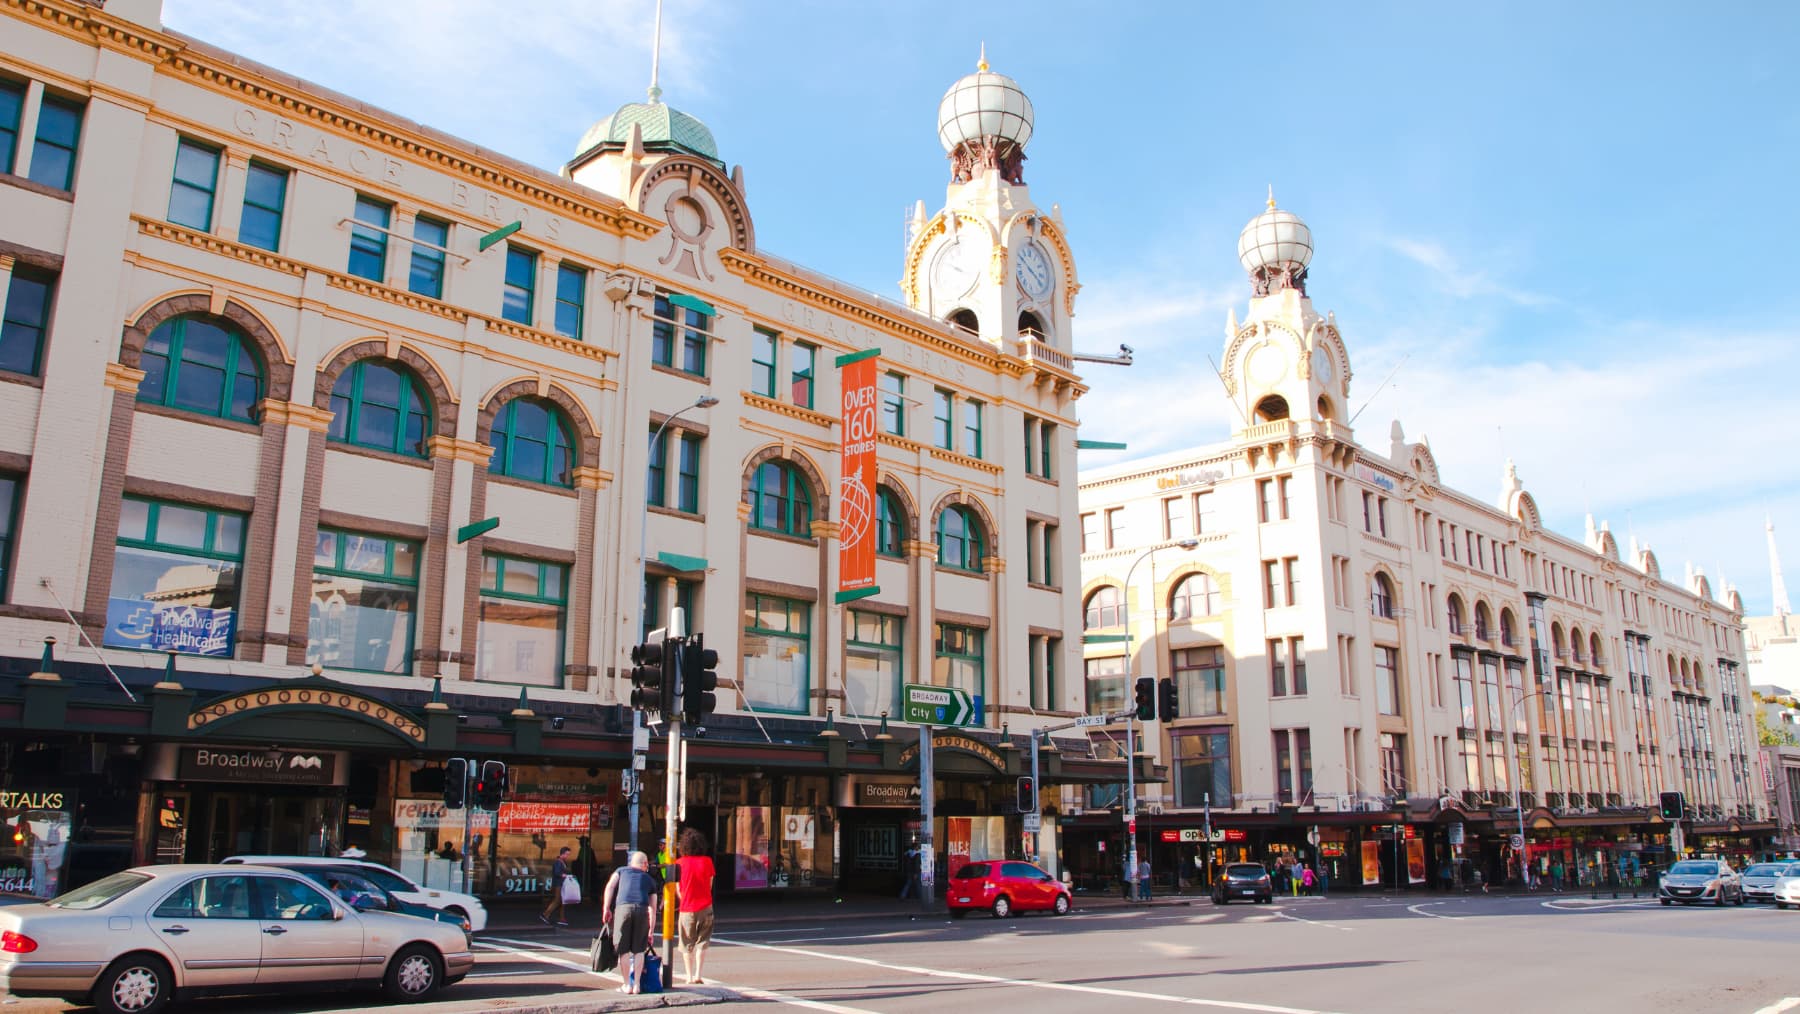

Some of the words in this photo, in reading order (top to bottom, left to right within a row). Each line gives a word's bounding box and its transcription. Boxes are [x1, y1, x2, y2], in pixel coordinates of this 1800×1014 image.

[451, 181, 561, 241] BROS
[844, 385, 875, 410] OVER
[843, 407, 875, 442] 160
[844, 439, 875, 457] STORES
[911, 691, 949, 703] BROADWAY
[911, 707, 930, 720] City
[1076, 717, 1091, 726] BAY
[1095, 716, 1104, 724] ST
[196, 749, 284, 772] Broadway
[866, 784, 908, 798] Broadway
[543, 813, 571, 826] rent
